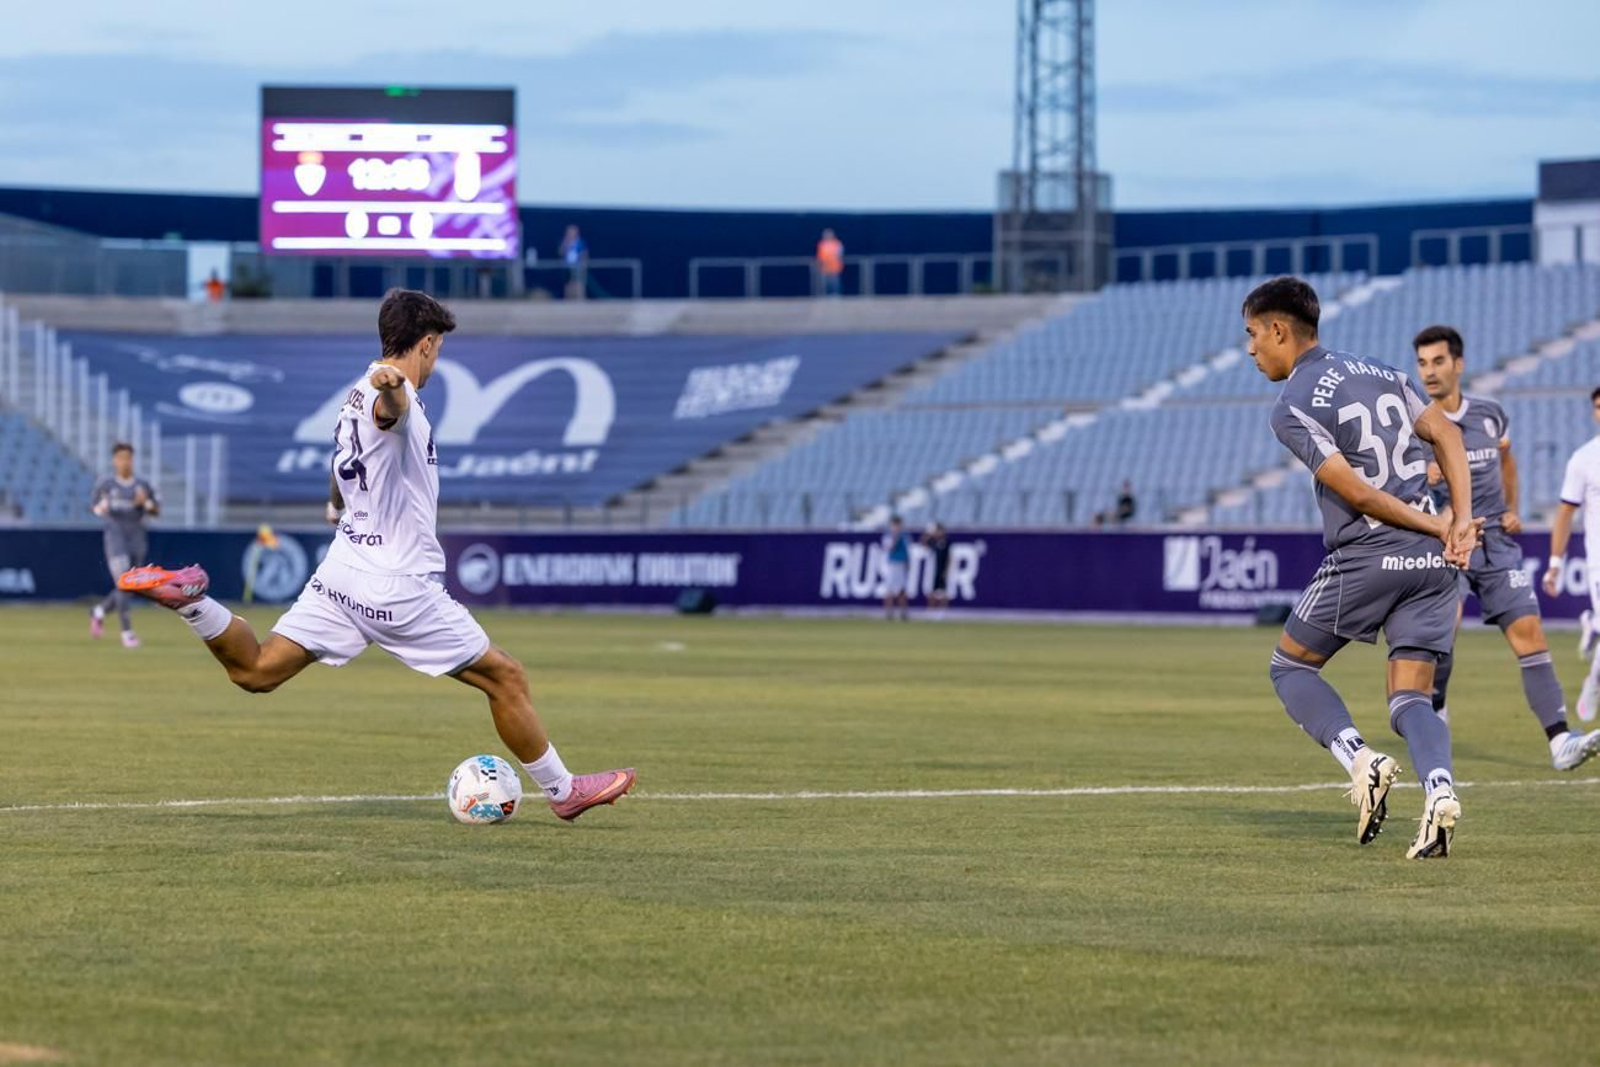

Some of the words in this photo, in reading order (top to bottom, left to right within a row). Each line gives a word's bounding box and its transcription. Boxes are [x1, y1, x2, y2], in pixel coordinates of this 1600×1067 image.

[1312, 367, 1346, 408] PERE
[1343, 360, 1395, 383] HARO
[1338, 393, 1426, 490] 32
[1200, 535, 1278, 590] Jaén
[327, 588, 393, 622] HYUNDAI
